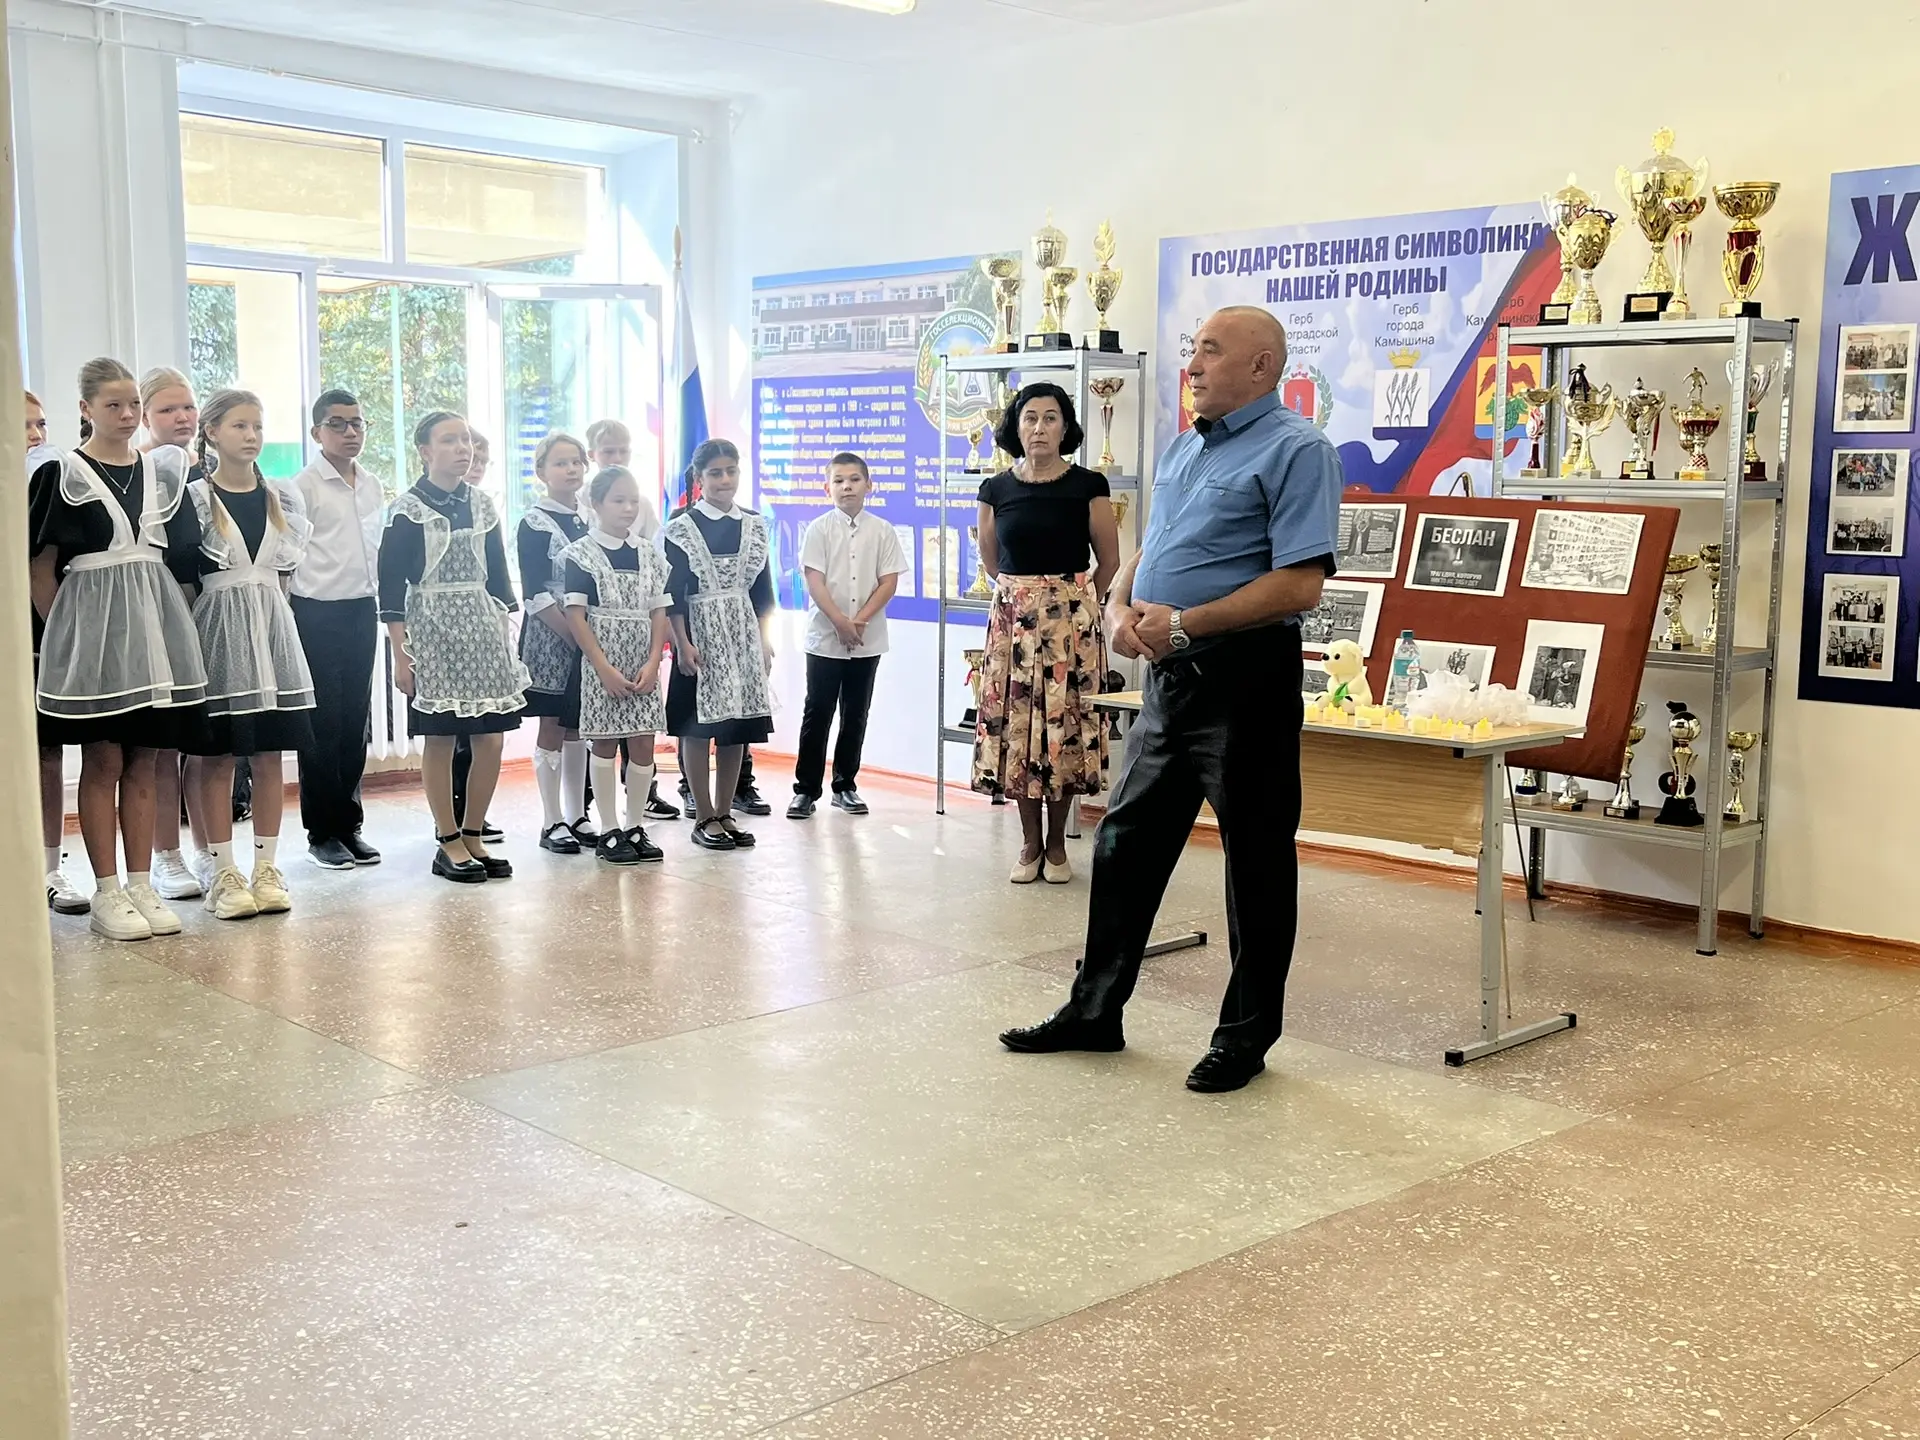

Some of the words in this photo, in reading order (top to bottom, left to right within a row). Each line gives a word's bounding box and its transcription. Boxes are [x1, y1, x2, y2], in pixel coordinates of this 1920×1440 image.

[1843, 191, 1920, 286] Ж
[1191, 236, 1389, 277] ГОСУДАРСТВЕННАЯ
[1395, 222, 1545, 260] СИМВОЛИКА
[1266, 268, 1340, 303] НАШЕЙ
[1345, 266, 1447, 300] РОДИНЫ
[1289, 312, 1313, 326] Герб
[1392, 302, 1419, 317] Герб
[929, 312, 994, 341] ГОССЕЛЕКЦИОННАЯ
[1386, 319, 1424, 334] города
[1374, 333, 1435, 347] Камышина
[1430, 526, 1496, 546] БЕСЛАН
